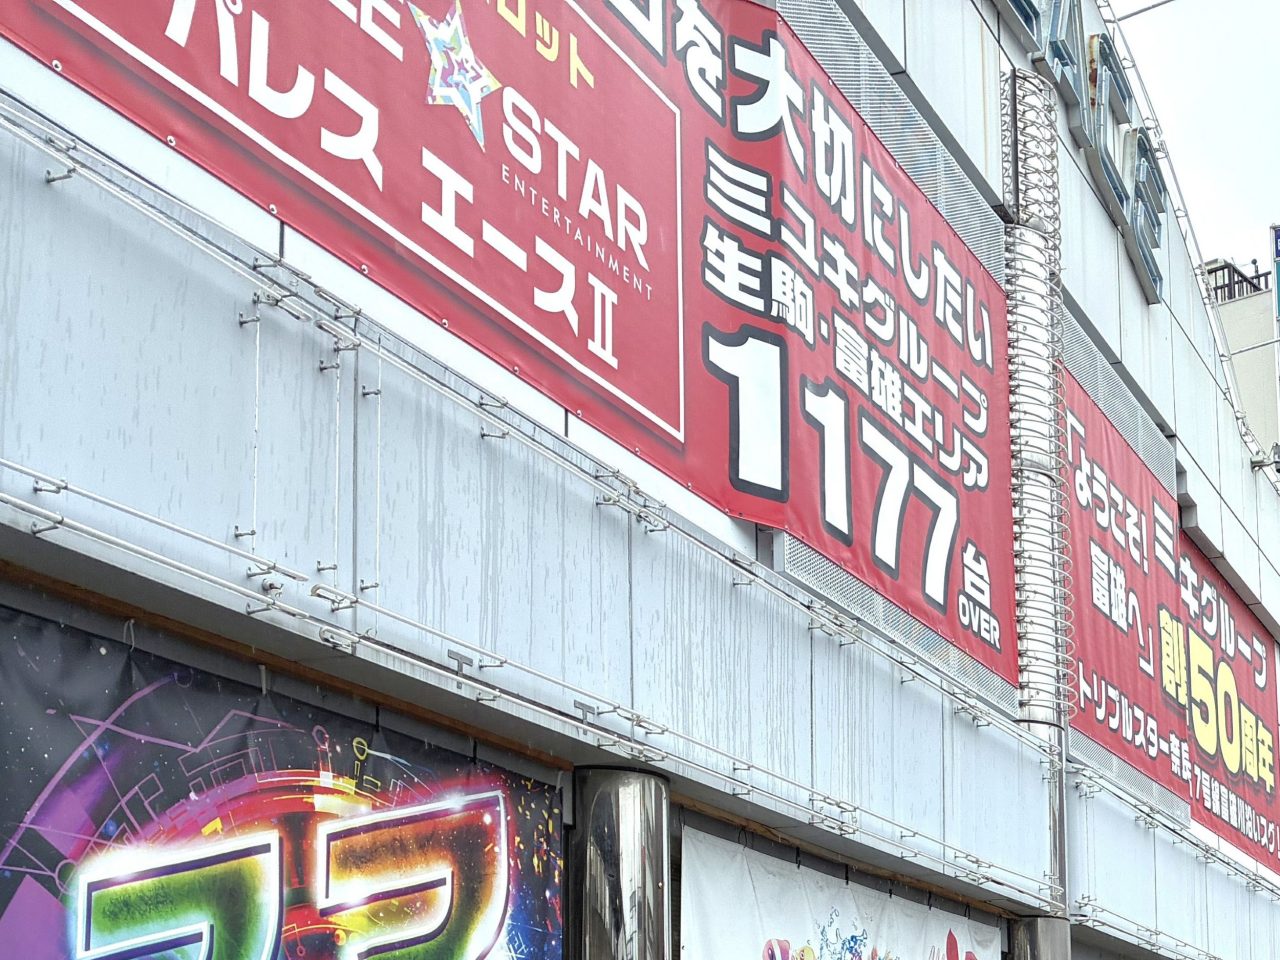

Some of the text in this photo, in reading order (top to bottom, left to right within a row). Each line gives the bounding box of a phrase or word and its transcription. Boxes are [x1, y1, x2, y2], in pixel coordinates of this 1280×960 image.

[502, 86, 651, 273] STAR
[502, 167, 653, 302] ENTERTAINMENT
[706, 144, 990, 437] ミユキグループ
[958, 594, 1001, 651] OVER
